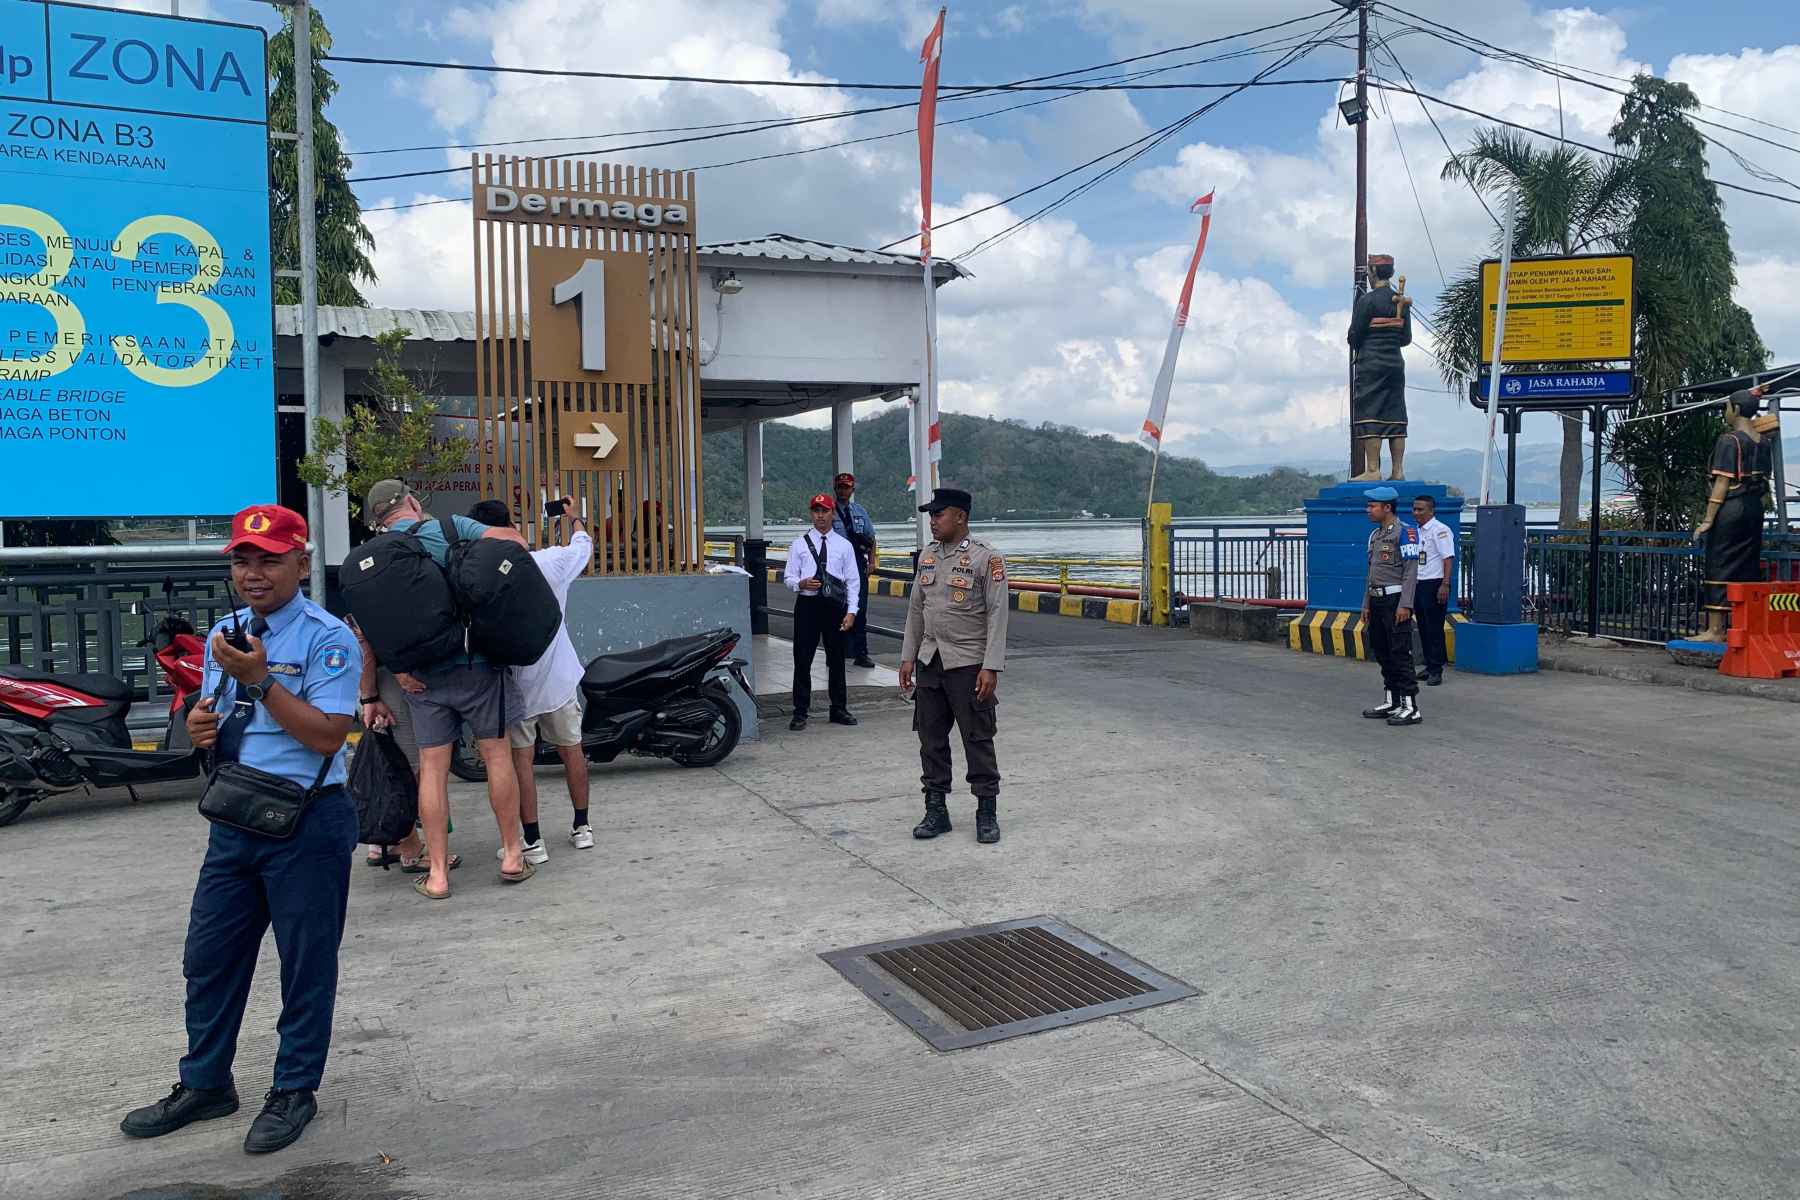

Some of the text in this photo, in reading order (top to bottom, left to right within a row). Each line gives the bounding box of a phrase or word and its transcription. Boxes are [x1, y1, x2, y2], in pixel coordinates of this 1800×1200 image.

[0, 45, 32, 83] p
[69, 33, 252, 96] ZONA
[8, 113, 154, 148] ZONA B3
[0, 143, 166, 170] AREA KENDARAAN
[486, 186, 688, 227] Dermaga
[47, 235, 122, 253] MENUJU
[137, 242, 160, 255] KE
[175, 244, 229, 259] KAPAL
[243, 248, 253, 261] &
[69, 256, 116, 272] ATAU
[131, 261, 256, 279] PEMERIKSAAN
[1530, 269, 1574, 277] PENUMPANG
[1581, 274, 1616, 282] RAHARJA
[112, 277, 256, 298] PENYEBRANGAN
[553, 258, 606, 372] 1
[9, 329, 257, 352] PEMERIKSAAN ATAU
[0, 349, 264, 370] LESS VALIDATOR TIKET
[0, 368, 51, 382] RAMP
[1528, 376, 1605, 389] JASA RAHARJA
[57, 389, 127, 404] BRIDGE
[0, 407, 111, 422] AGA BETON
[0, 426, 126, 441] AGA PONTON
[952, 566, 974, 575] POLRI
